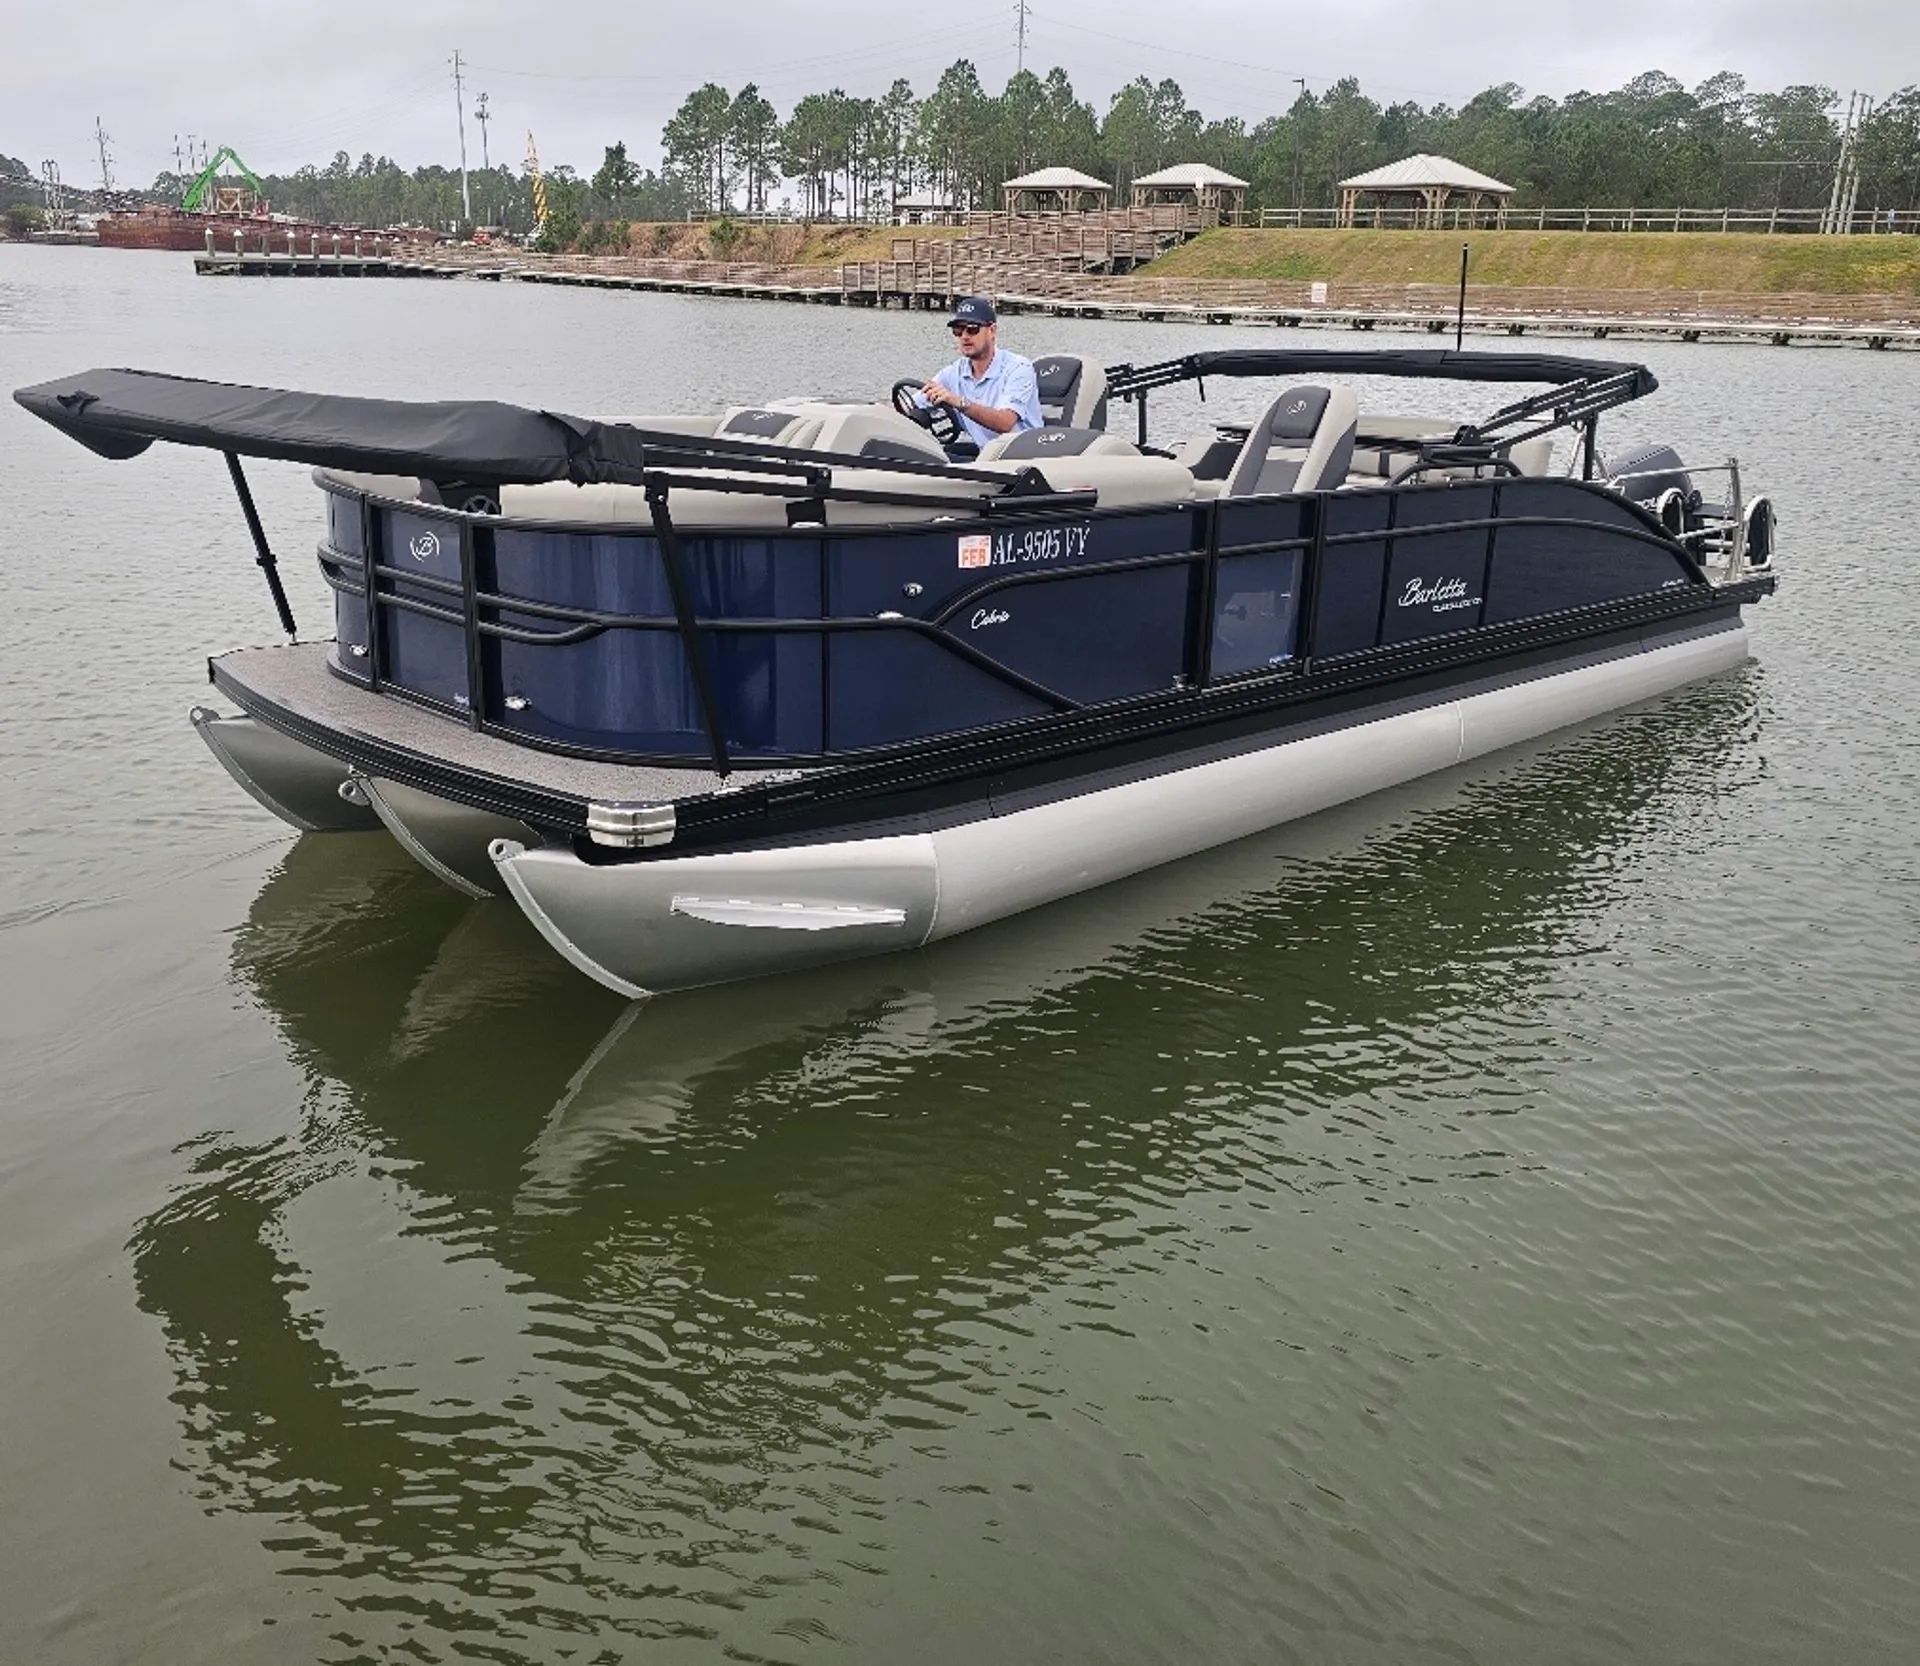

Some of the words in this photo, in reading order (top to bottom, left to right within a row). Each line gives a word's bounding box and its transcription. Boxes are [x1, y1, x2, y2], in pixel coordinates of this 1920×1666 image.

[962, 547, 986, 566] FEB
[993, 529, 1061, 565] AL-9505
[1398, 577, 1467, 606] Barletta
